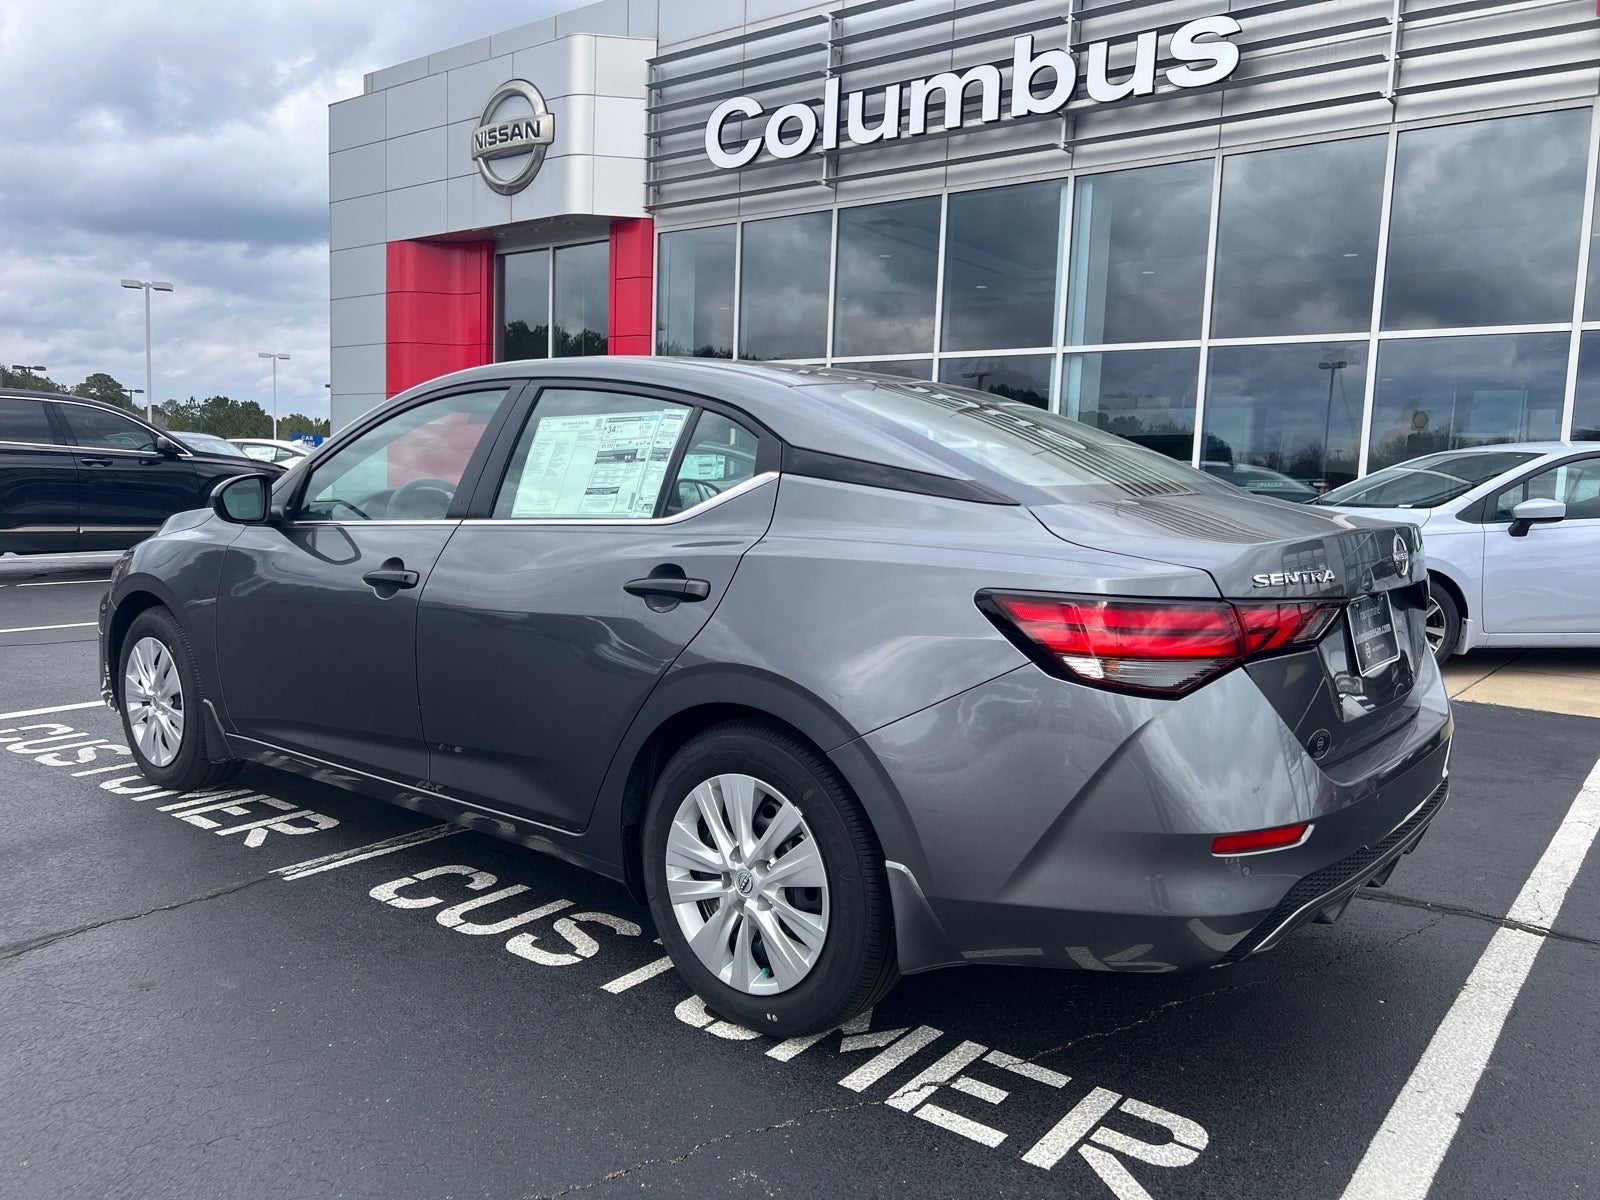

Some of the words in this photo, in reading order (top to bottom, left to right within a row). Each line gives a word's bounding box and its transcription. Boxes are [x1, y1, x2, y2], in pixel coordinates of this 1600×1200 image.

[704, 15, 1242, 169] Columbus
[473, 119, 541, 153] NISSAN
[1253, 569, 1336, 588] SENTRA
